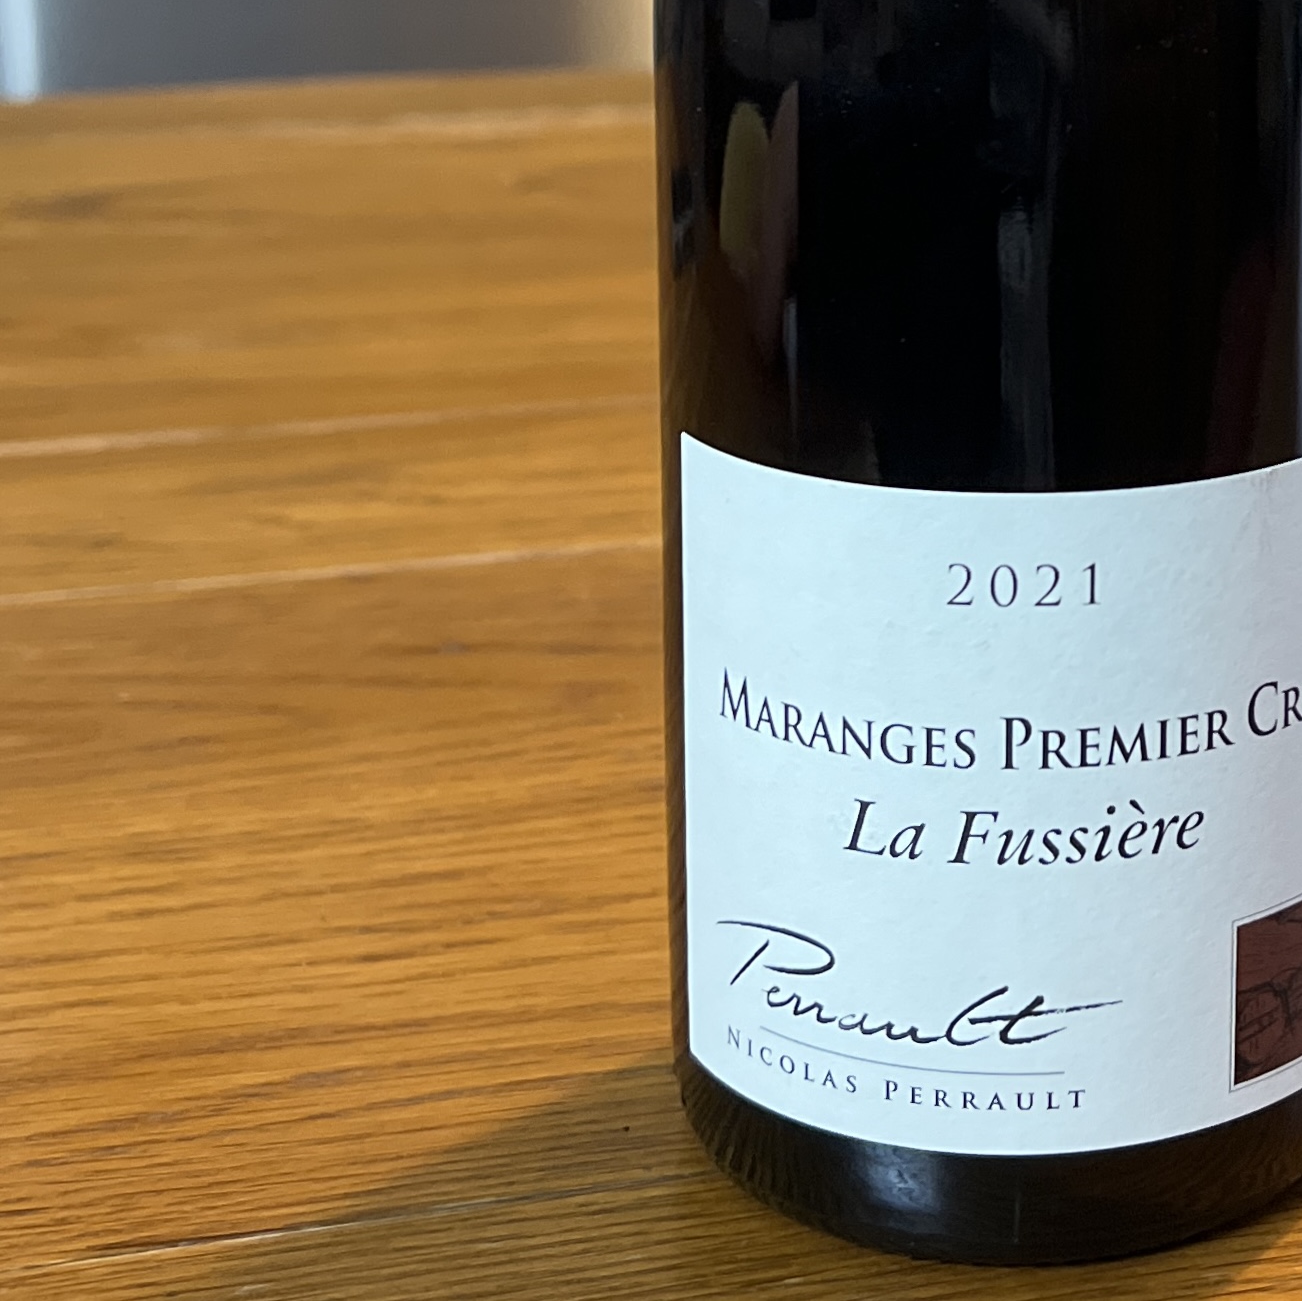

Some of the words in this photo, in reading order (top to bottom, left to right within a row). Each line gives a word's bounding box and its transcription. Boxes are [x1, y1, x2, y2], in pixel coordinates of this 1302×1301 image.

[946, 561, 1102, 609] 2021
[719, 667, 978, 770] MARANGES
[1000, 707, 1236, 770] PREMIER
[843, 798, 924, 861] La
[947, 800, 1205, 866] Fussière
[715, 920, 1124, 1046] Perrault
[726, 1026, 858, 1094] NICOLAS
[885, 1079, 1086, 1111] PERRAULT
